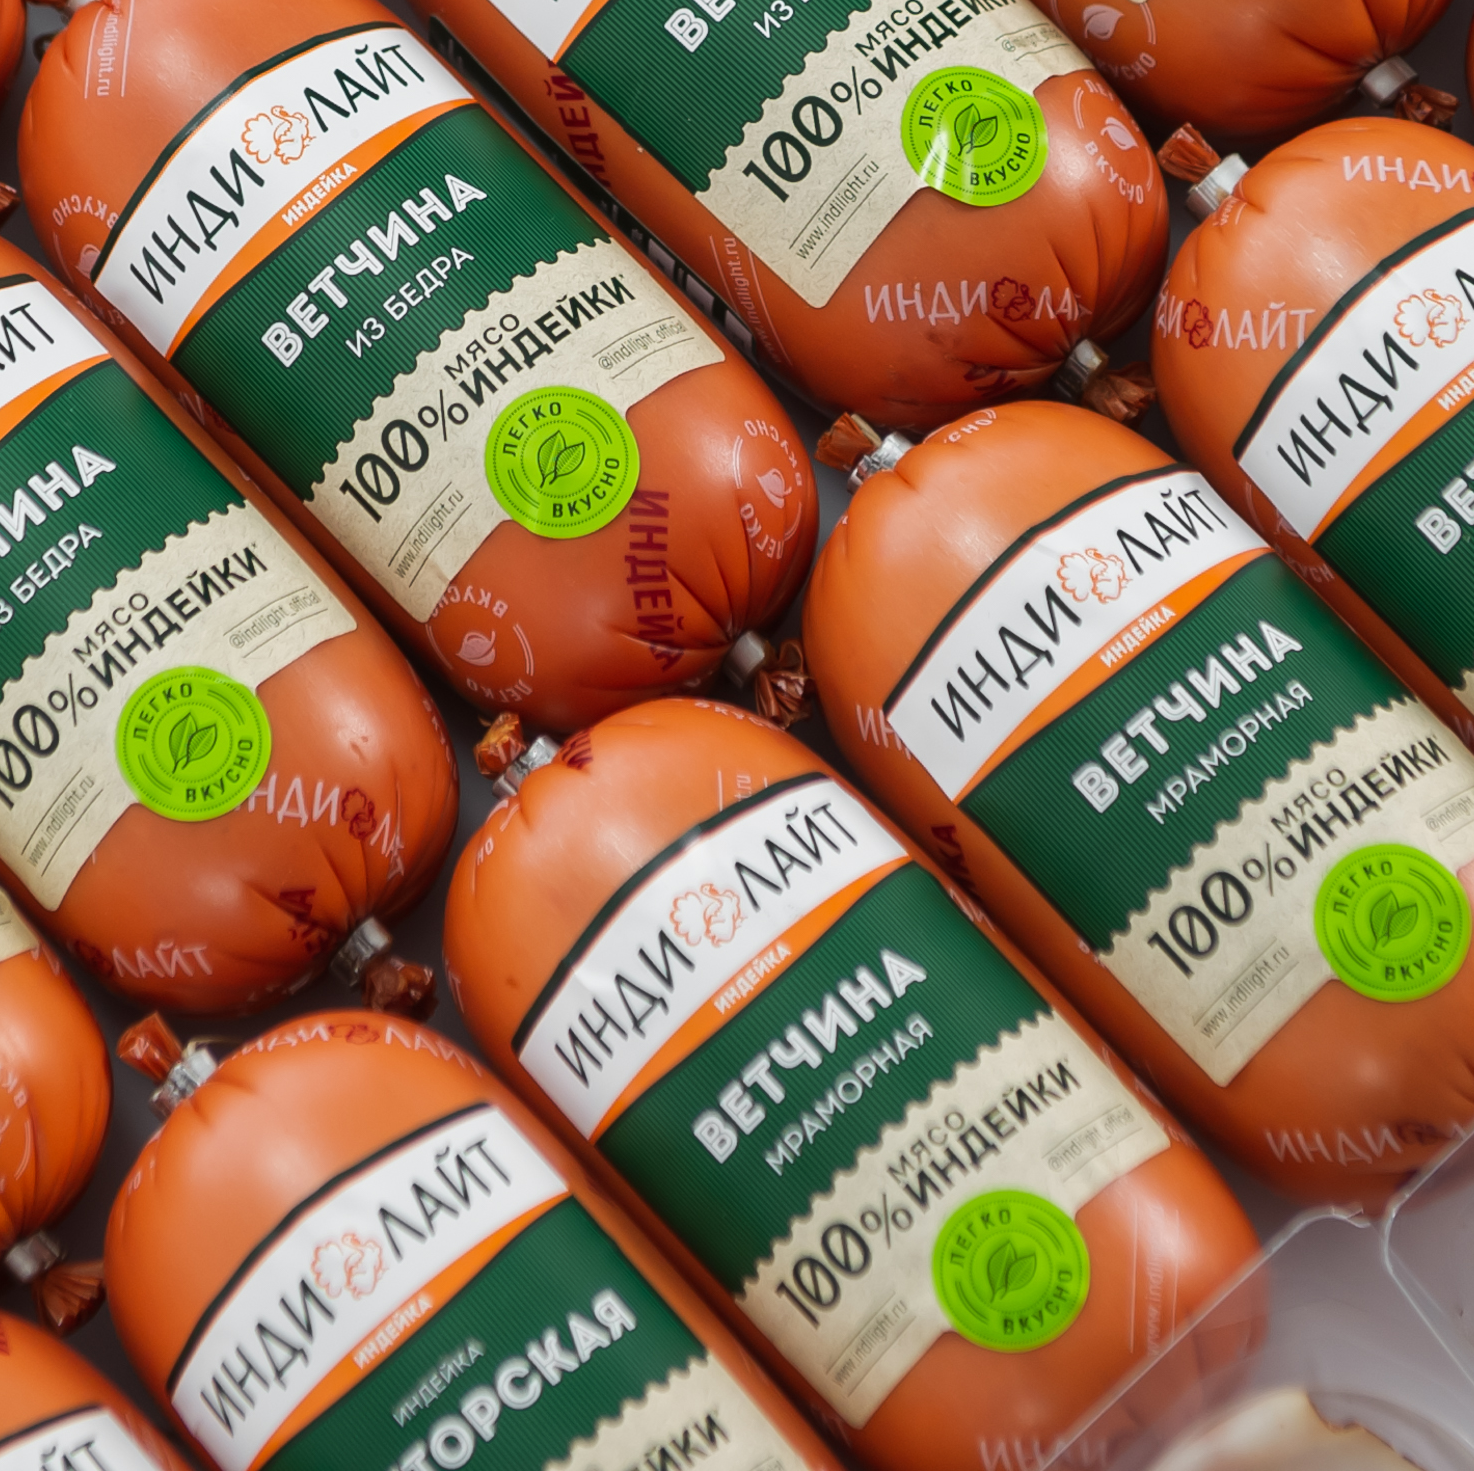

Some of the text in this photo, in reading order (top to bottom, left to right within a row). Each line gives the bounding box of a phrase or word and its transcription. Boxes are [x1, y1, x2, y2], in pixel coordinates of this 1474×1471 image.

[753, 0, 795, 38] ИЗ
[742, 66, 883, 204] 100%
[918, 77, 974, 128] ЛЕГКО
[282, 161, 358, 226] ИНДЕЙКА
[969, 131, 1032, 187] ВКУСНО
[261, 173, 487, 368] ВЕТЧИНА
[345, 247, 475, 357] ИЗ БЕДРА
[443, 312, 520, 379] МЯСО
[466, 277, 636, 406] ИНДЕЙКИ
[340, 389, 469, 523] 100%
[502, 401, 562, 457] ЛЕГКО
[552, 456, 620, 519] ВКУСНО
[9, 521, 103, 605] БЕДРА
[395, 489, 463, 579] www.indilight.ru
[95, 547, 268, 688] ИНДЕЙКИ
[1072, 619, 1303, 813] ВЕТЧИНА
[1145, 680, 1313, 825] МРАМОРНАЯ
[1270, 768, 1346, 834] МЯСО
[1291, 738, 1450, 861] ИНДЕЙКИ
[694, 949, 926, 1163] ВЕТЧИНА
[765, 1014, 932, 1176] МРАМОРНАЯ
[777, 1193, 912, 1329] 100%
[949, 1208, 1011, 1266] ЛЕГКО
[1003, 1267, 1072, 1334] ВКУСНО
[393, 1340, 484, 1427] ИНДЕЙКА
